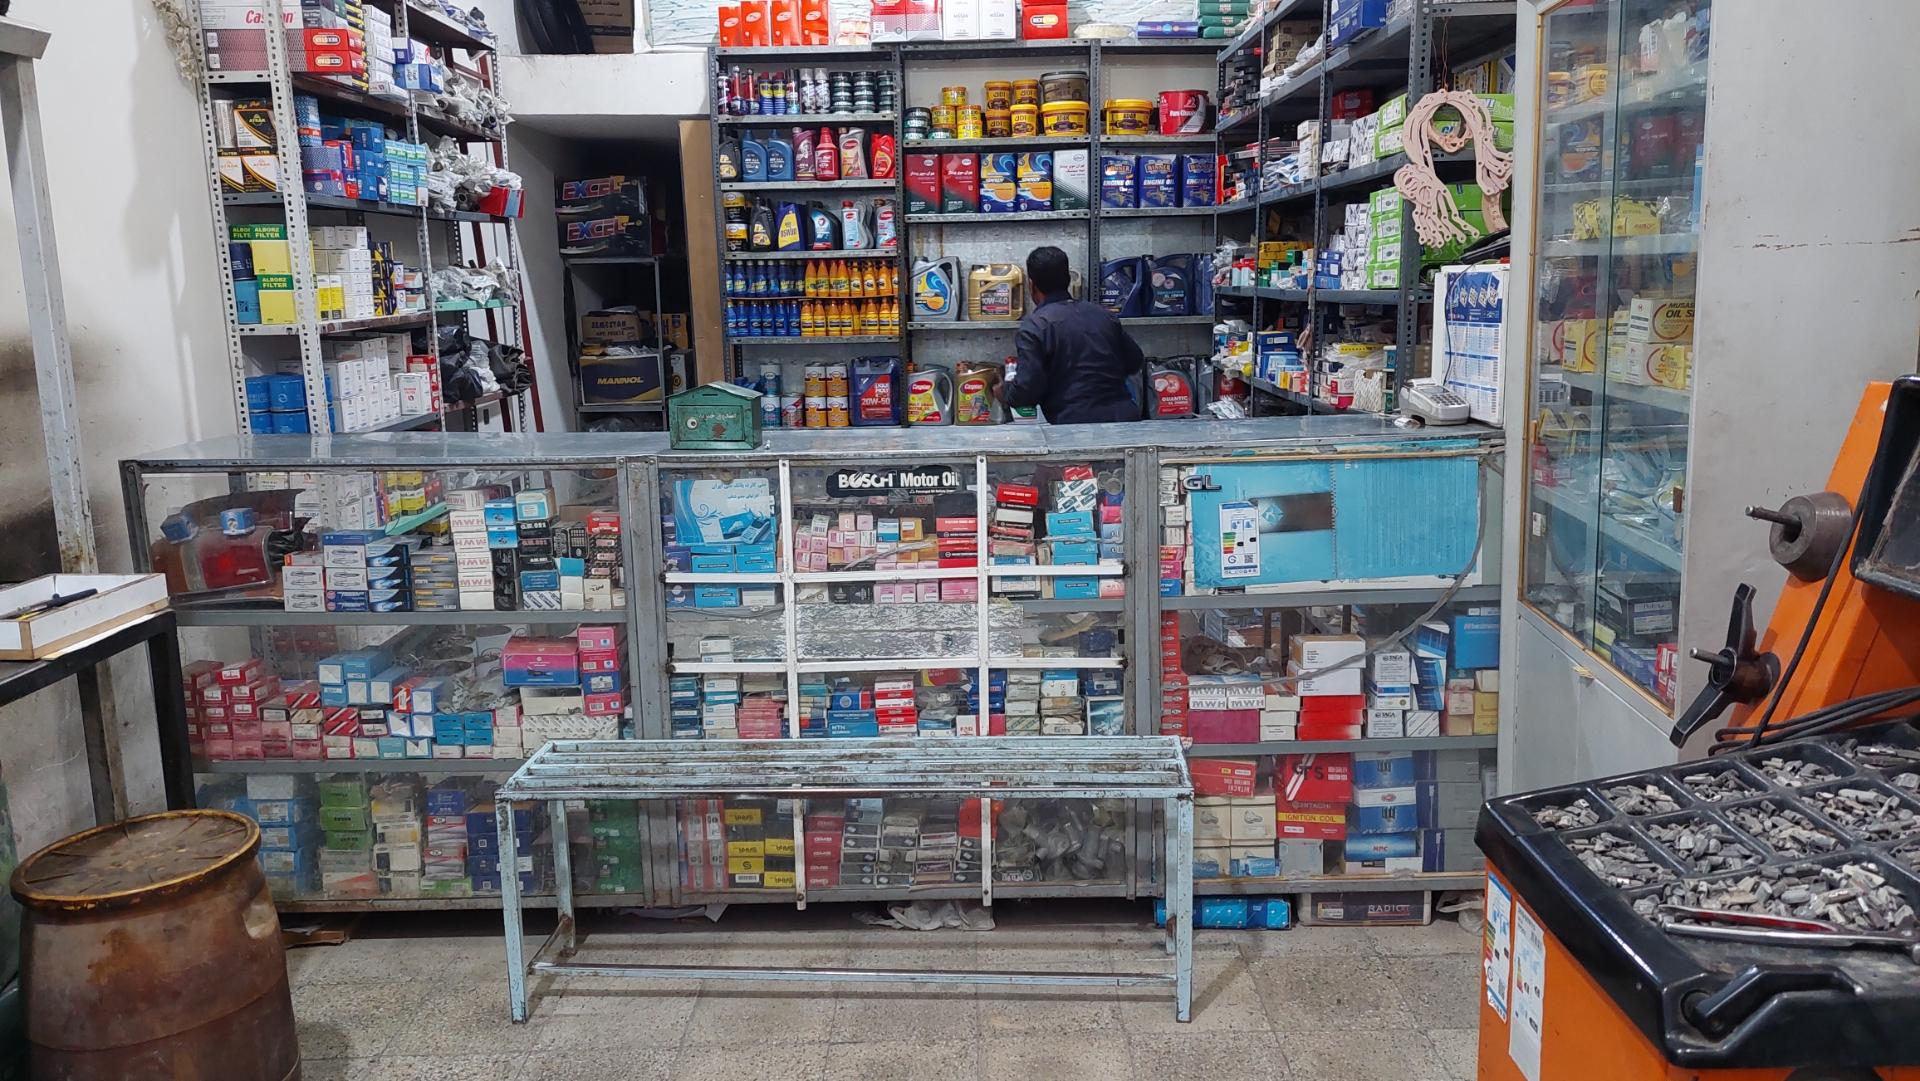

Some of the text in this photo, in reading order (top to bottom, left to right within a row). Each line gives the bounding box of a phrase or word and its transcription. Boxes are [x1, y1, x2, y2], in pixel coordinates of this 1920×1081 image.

[567, 216, 626, 242] EXCEL
[1666, 310, 1681, 318] OIL
[597, 376, 644, 385] MANNOL
[900, 472, 939, 487] Motor
[942, 472, 959, 486] Oil
[1183, 474, 1222, 490] GL
